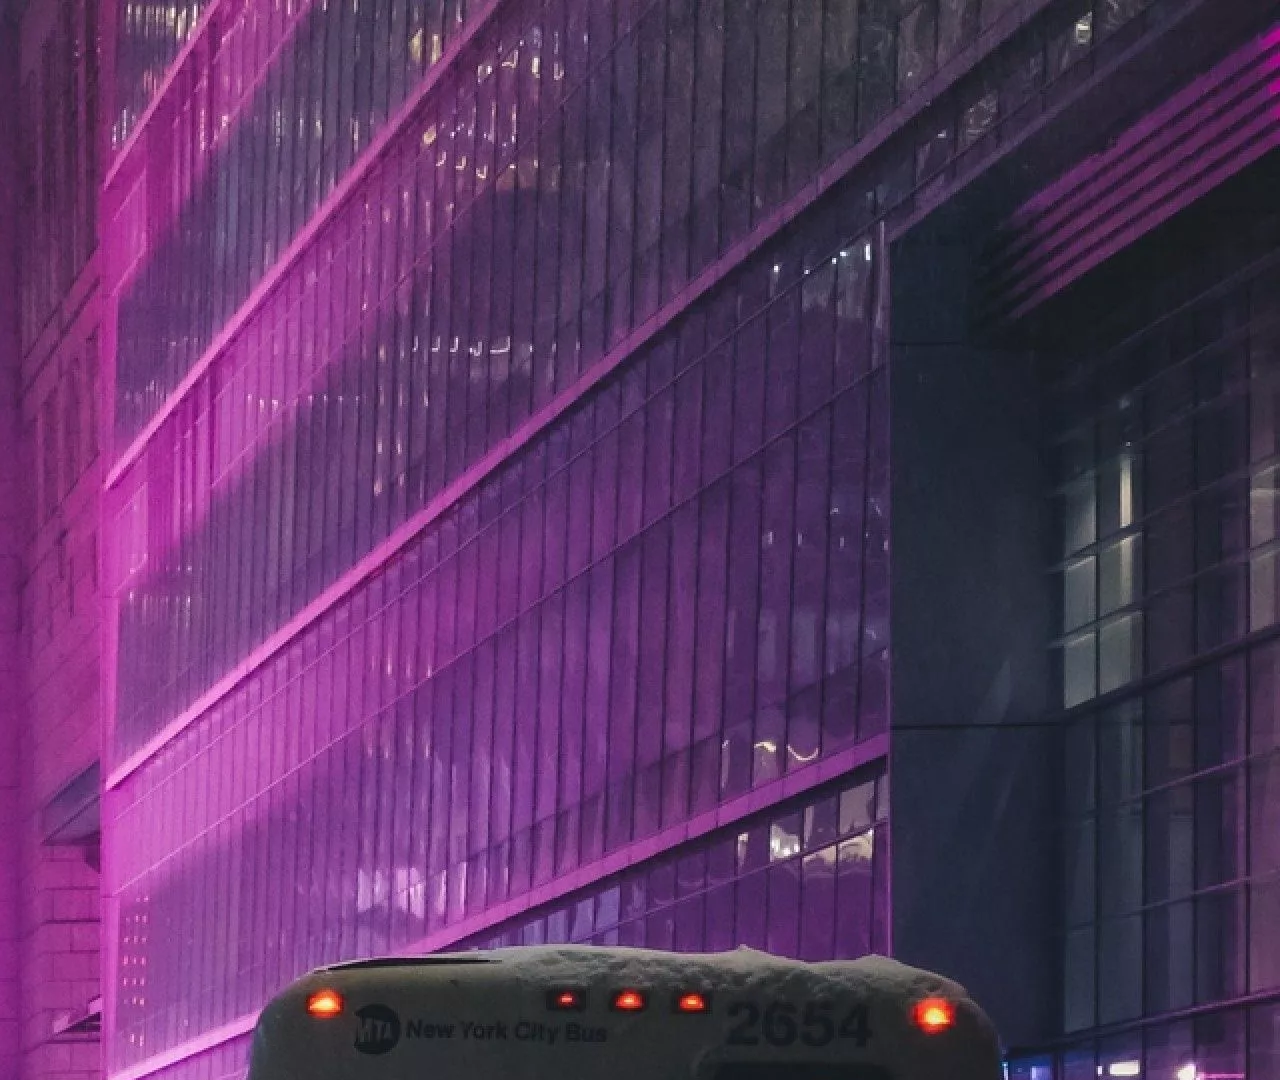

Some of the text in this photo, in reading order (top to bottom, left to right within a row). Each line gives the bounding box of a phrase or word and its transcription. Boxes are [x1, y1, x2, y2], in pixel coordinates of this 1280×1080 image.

[405, 1019, 453, 1041] New
[461, 1019, 508, 1041] York
[514, 1021, 561, 1046] City
[567, 1022, 608, 1043] Bus
[726, 1000, 873, 1048] 2654
